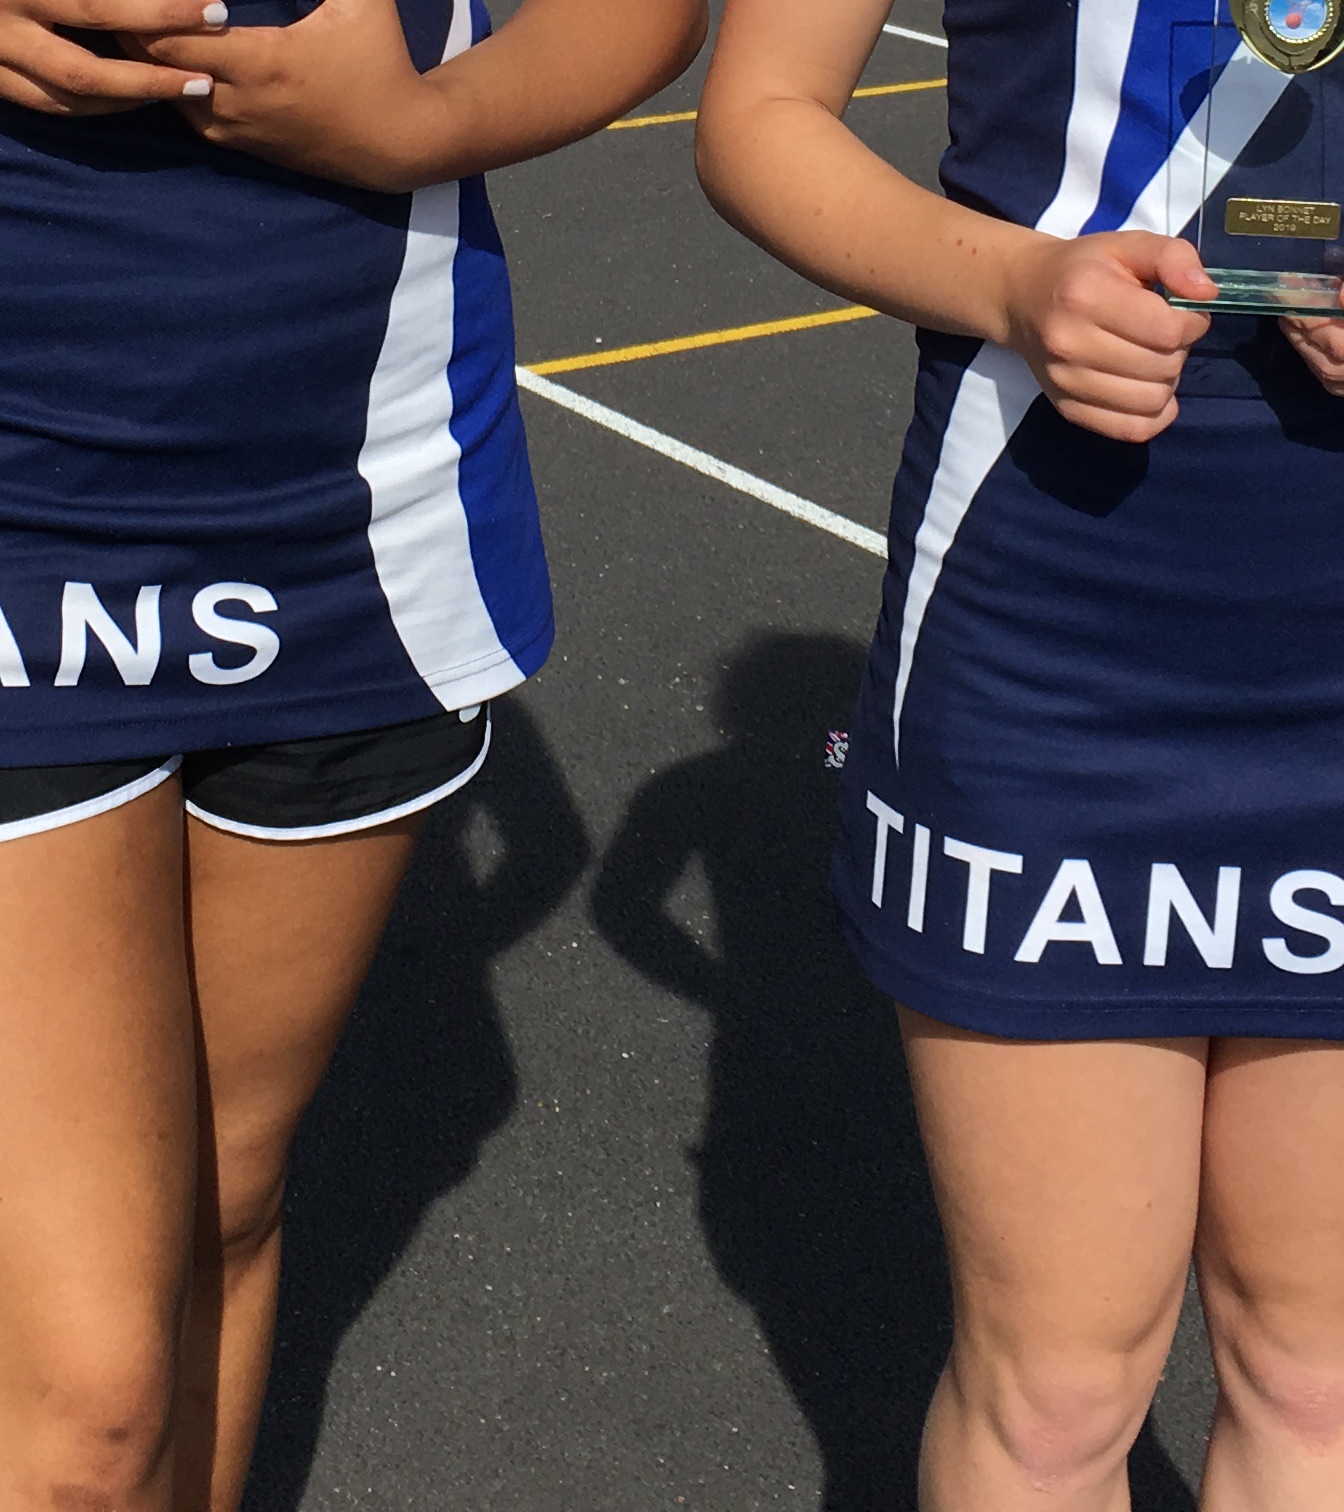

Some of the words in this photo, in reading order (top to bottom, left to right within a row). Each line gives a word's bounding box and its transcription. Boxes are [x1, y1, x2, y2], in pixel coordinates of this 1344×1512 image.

[1239, 212, 1275, 222] PLAYER
[1276, 214, 1290, 222] OF
[1291, 214, 1311, 224] THE
[1313, 215, 1331, 224] DAY
